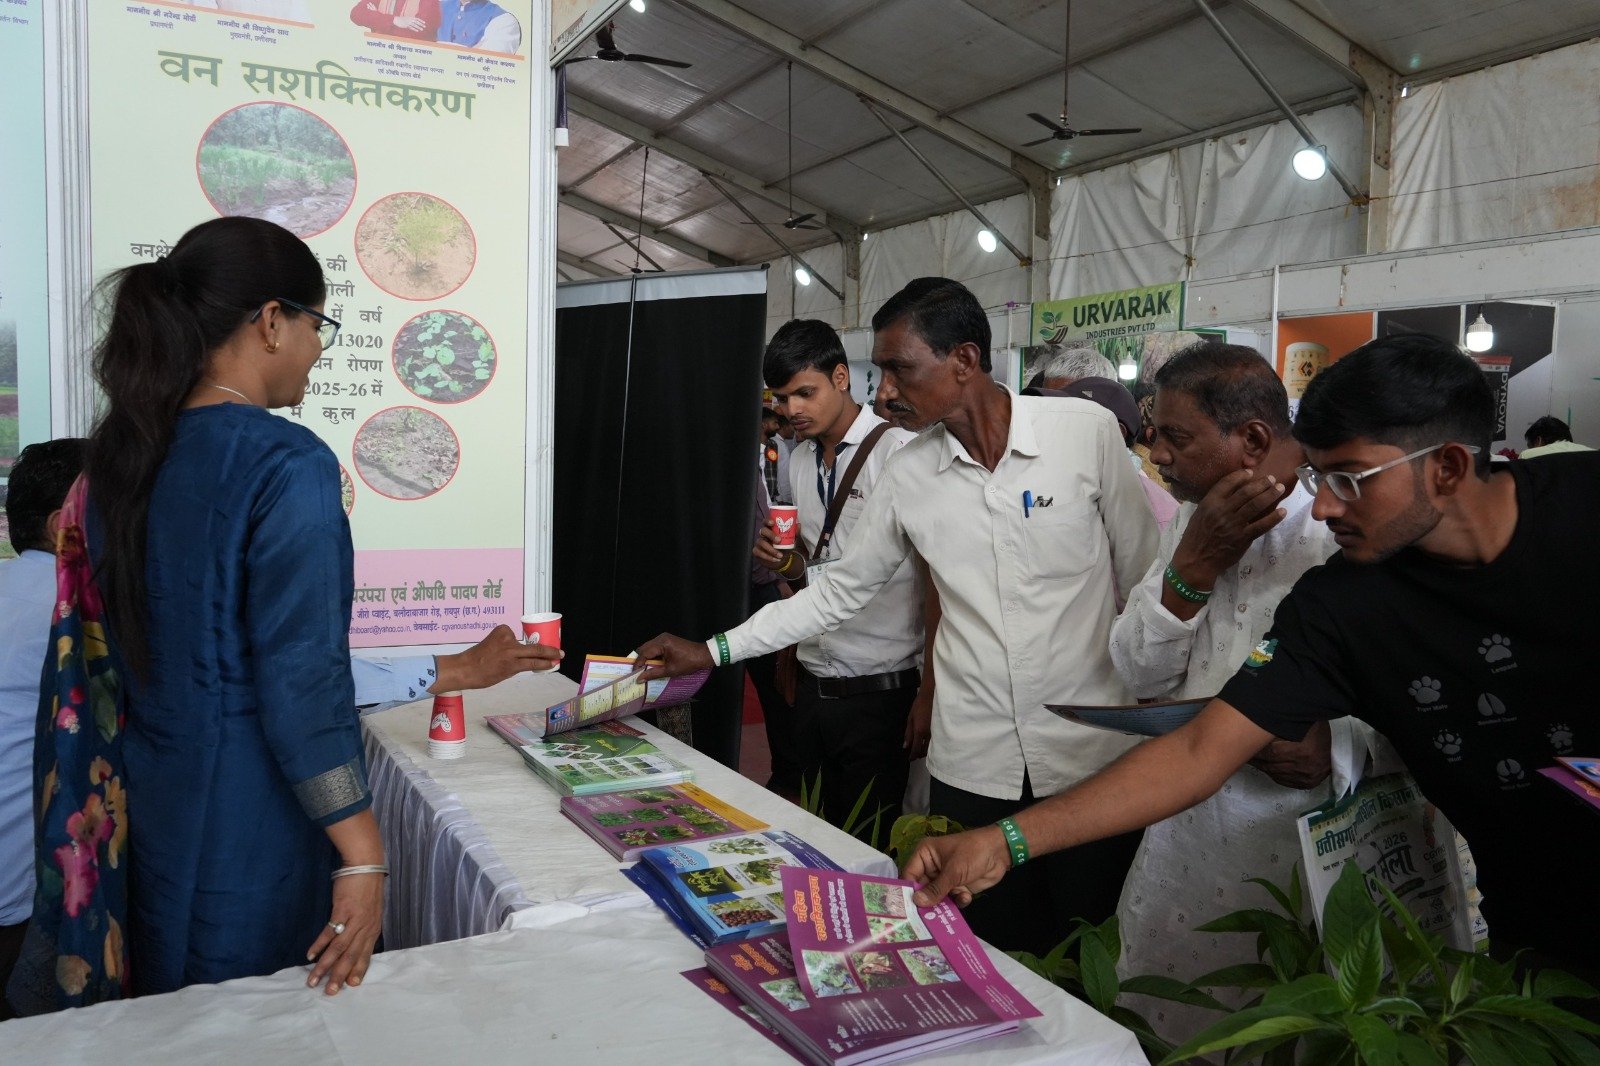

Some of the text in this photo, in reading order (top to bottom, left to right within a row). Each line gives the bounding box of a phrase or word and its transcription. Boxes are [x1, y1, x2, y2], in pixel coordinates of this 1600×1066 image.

[153, 8, 161, 17] श्री
[183, 11, 196, 22] मोदी
[242, 21, 250, 30] श्री
[157, 50, 476, 120] वन सशक्तिकरण
[326, 254, 347, 272] की
[331, 303, 383, 323] में वर्ष
[1073, 290, 1172, 328] URVARAK
[1086, 322, 1156, 340] INDUSTRIES PVT LTD
[347, 354, 383, 372] रोपण
[304, 379, 383, 397] 2025-26 में
[1496, 372, 1508, 434] DYNOVA
[322, 407, 356, 425] कुल
[391, 581, 408, 606] एवं
[412, 580, 447, 601] औषधि
[450, 585, 479, 601] पादप
[483, 578, 504, 600] बोर्ड
[483, 605, 505, 615] 493111
[1383, 832, 1408, 850] 2026
